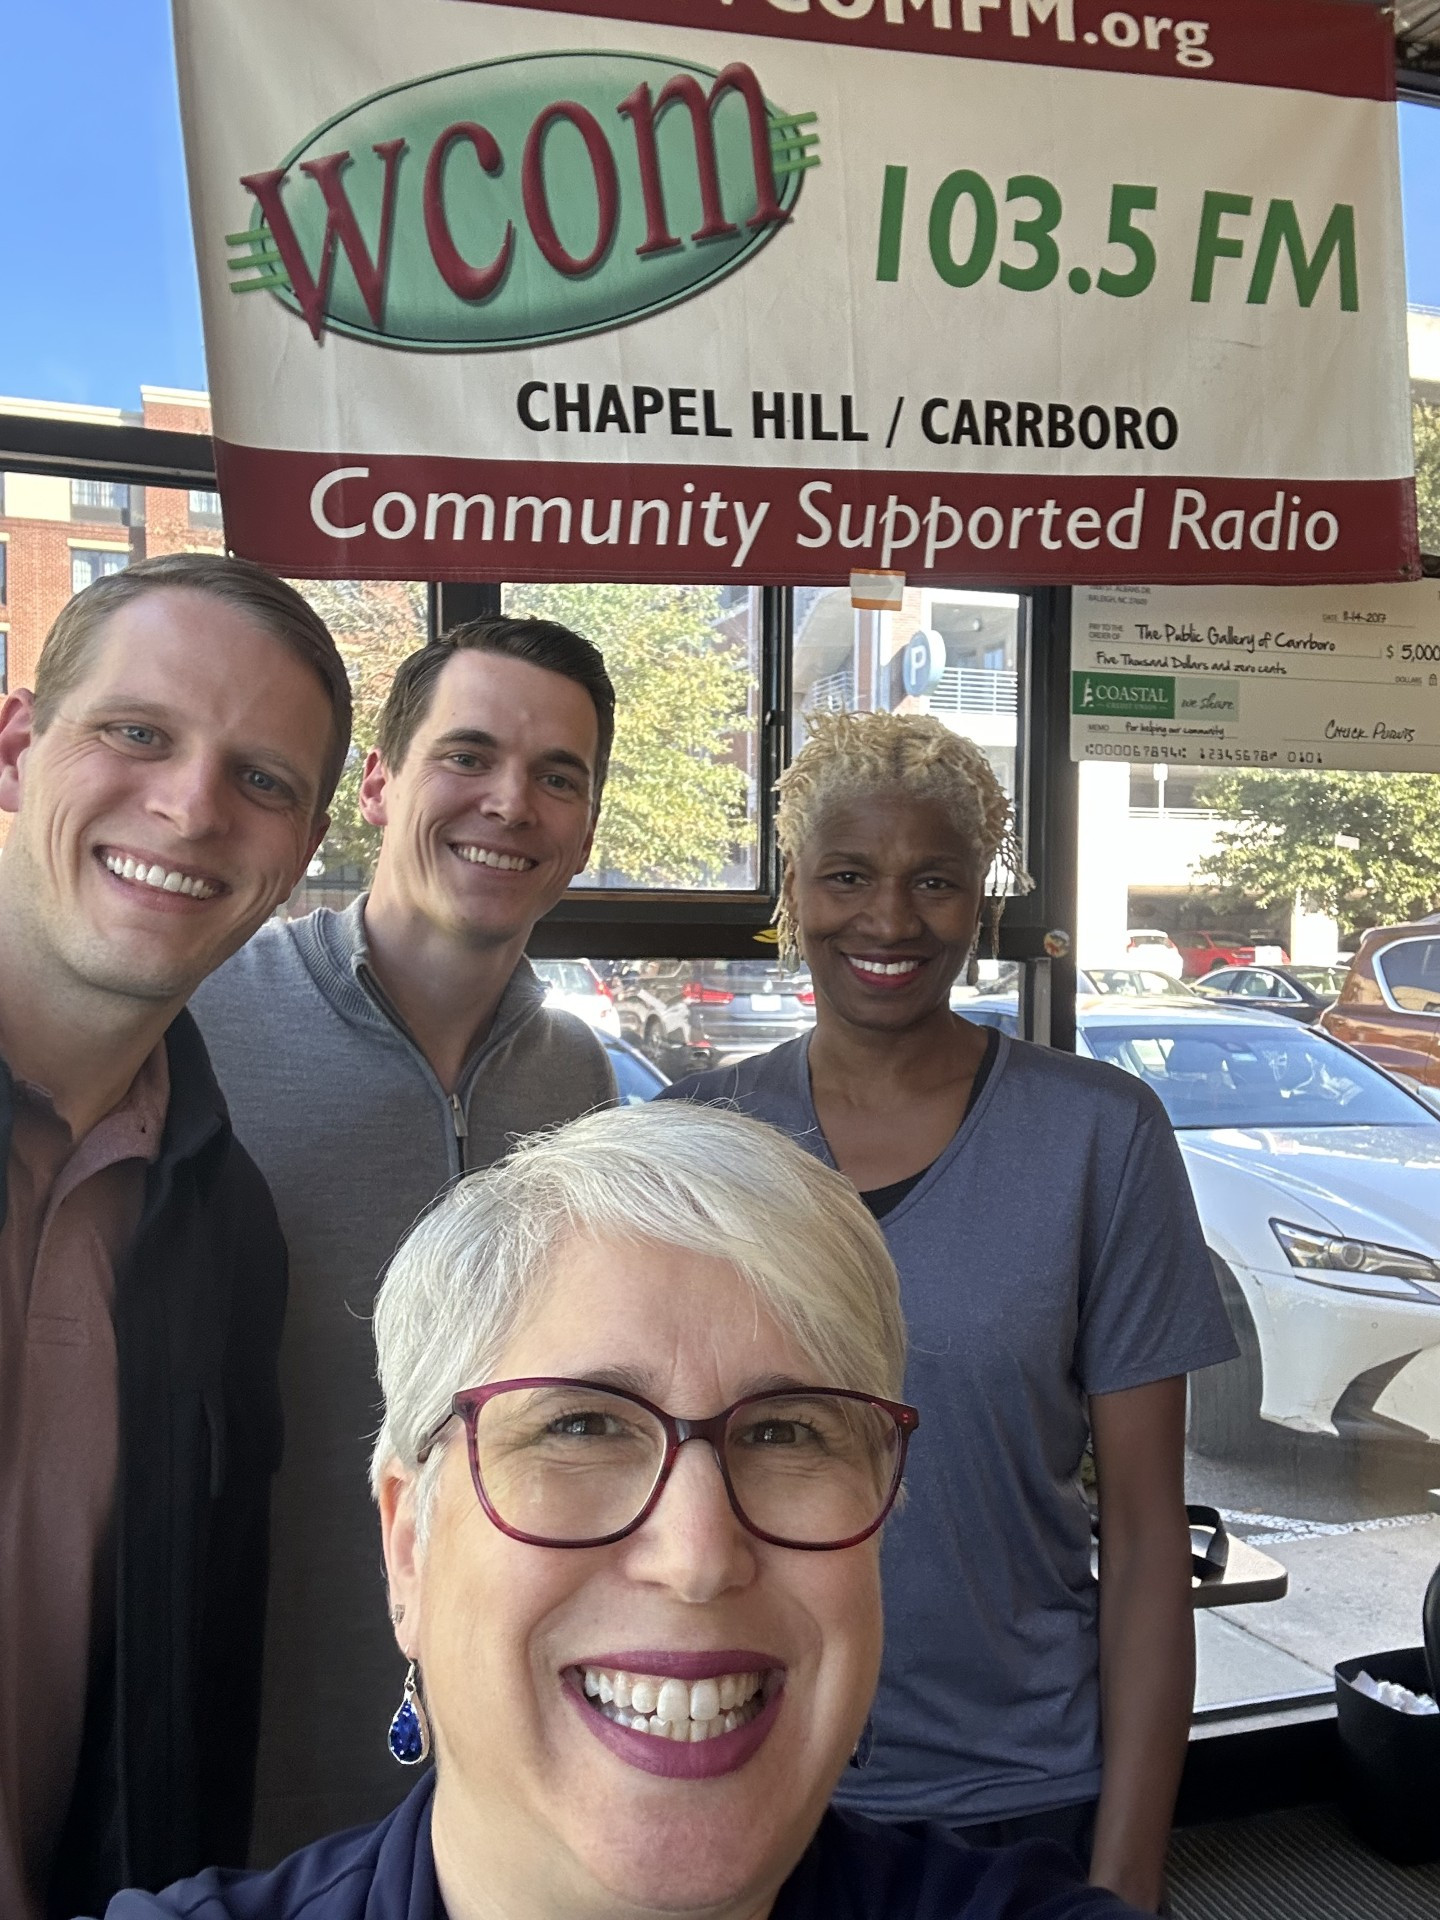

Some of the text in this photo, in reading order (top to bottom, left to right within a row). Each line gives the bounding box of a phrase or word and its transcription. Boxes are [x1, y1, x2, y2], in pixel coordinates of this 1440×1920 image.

[875, 163, 1360, 312] 103.5 FM
[516, 380, 1180, 451] CHAPEL HILL / CARRBORO
[310, 466, 1340, 570] Community Supported Radio
[1088, 631, 1121, 640] ORDER OF
[1101, 623, 1111, 631] TO
[1111, 624, 1124, 632] THE
[1134, 623, 1336, 653] The Public Gallery of Carrboro
[1386, 644, 1395, 659] $
[910, 645, 927, 685] P
[1096, 651, 1288, 675] Five Thousand Dollars and zero cents
[1395, 675, 1422, 684] DOLLARS
[1095, 685, 1169, 703] COASTAL
[1088, 723, 1110, 732] MEMO
[1140, 721, 1167, 737] helping
[1168, 726, 1181, 735] our
[1183, 724, 1225, 740] community
[1287, 750, 1322, 764] 0101
